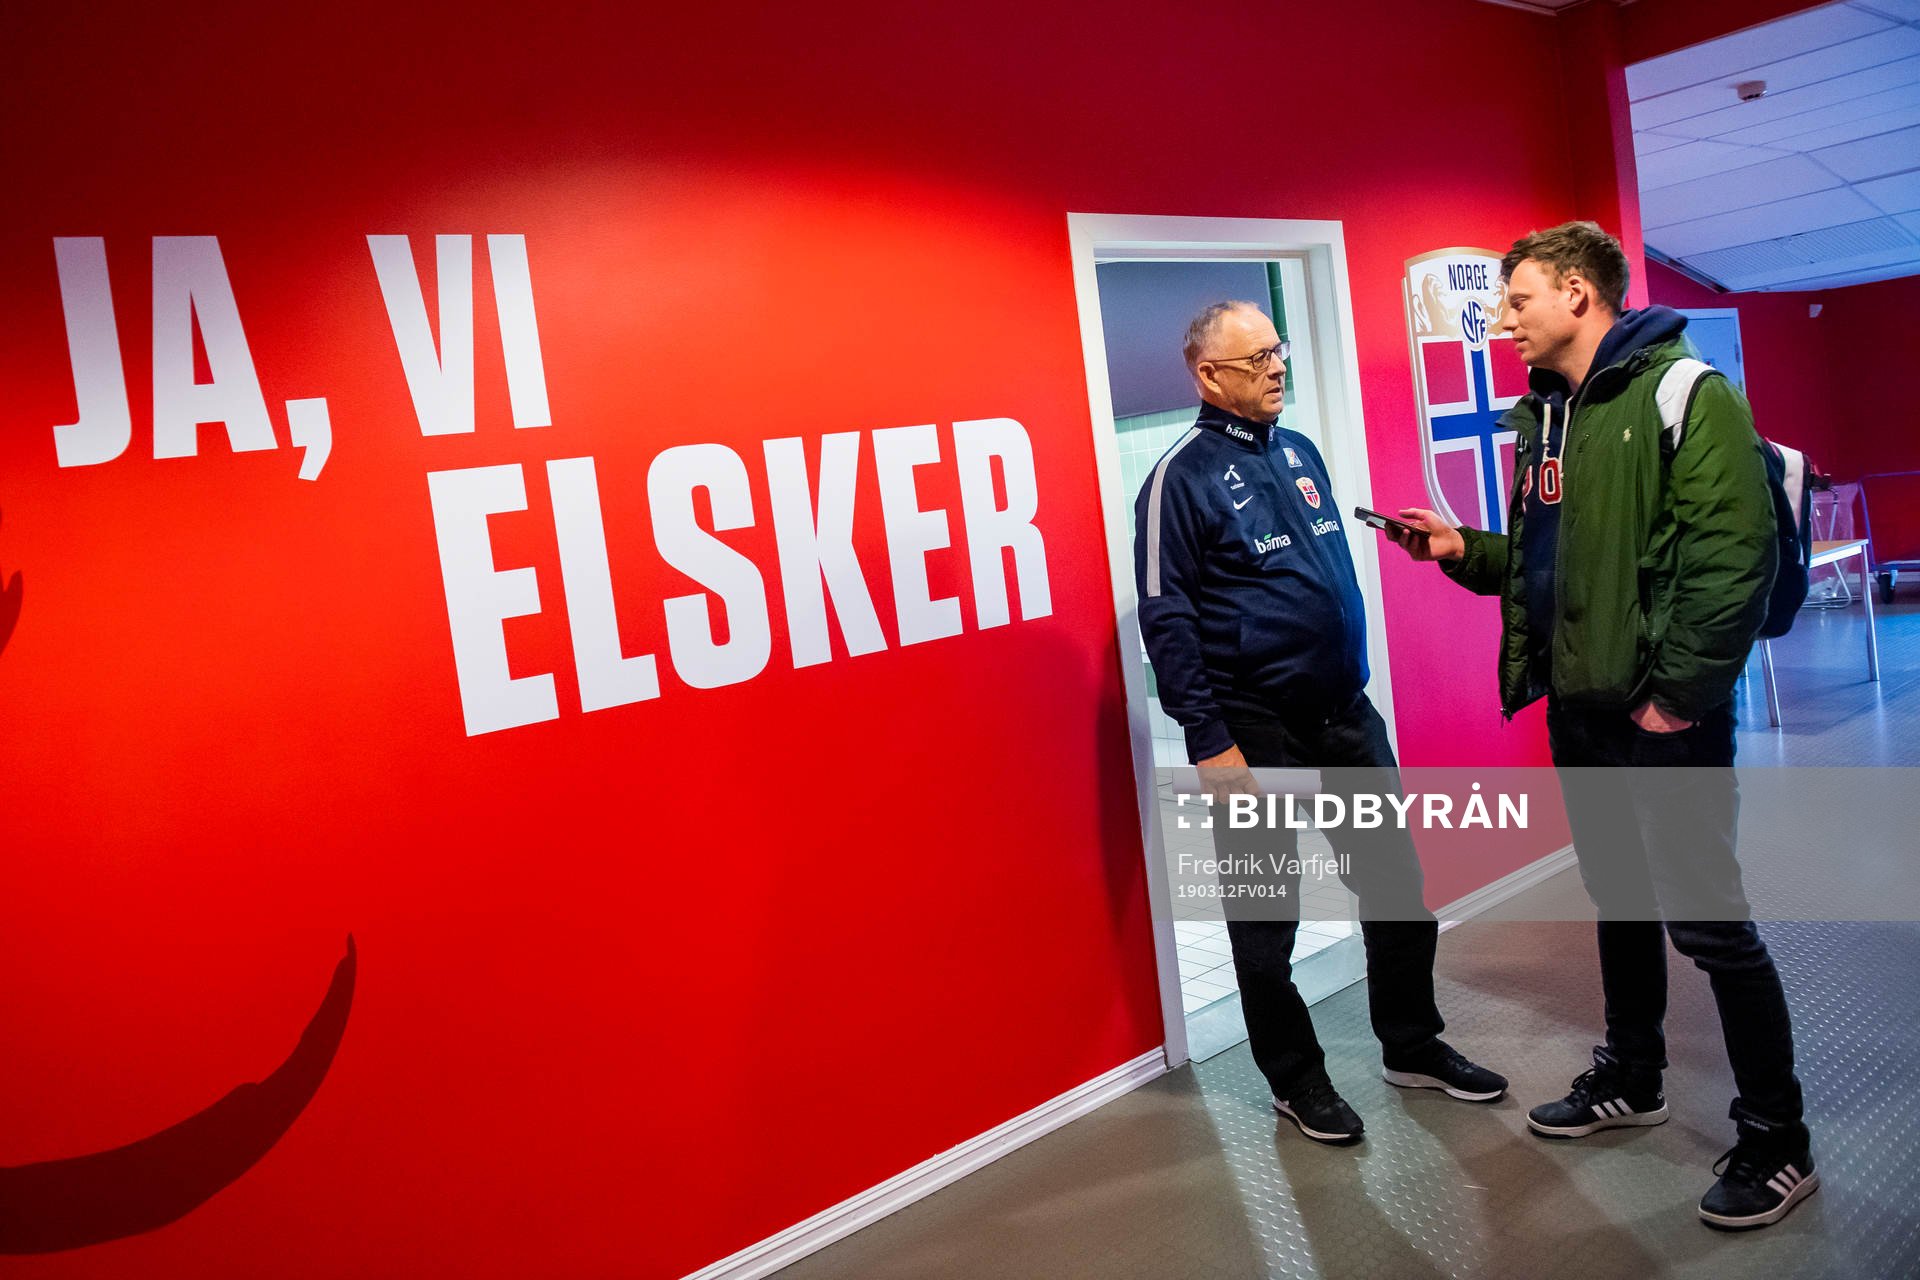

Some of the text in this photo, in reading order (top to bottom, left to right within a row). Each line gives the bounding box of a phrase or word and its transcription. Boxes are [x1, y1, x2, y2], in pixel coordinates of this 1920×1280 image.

[52, 233, 553, 481] JA, VI
[1448, 263, 1489, 291] NORGE
[427, 417, 1053, 737] ELSKER
